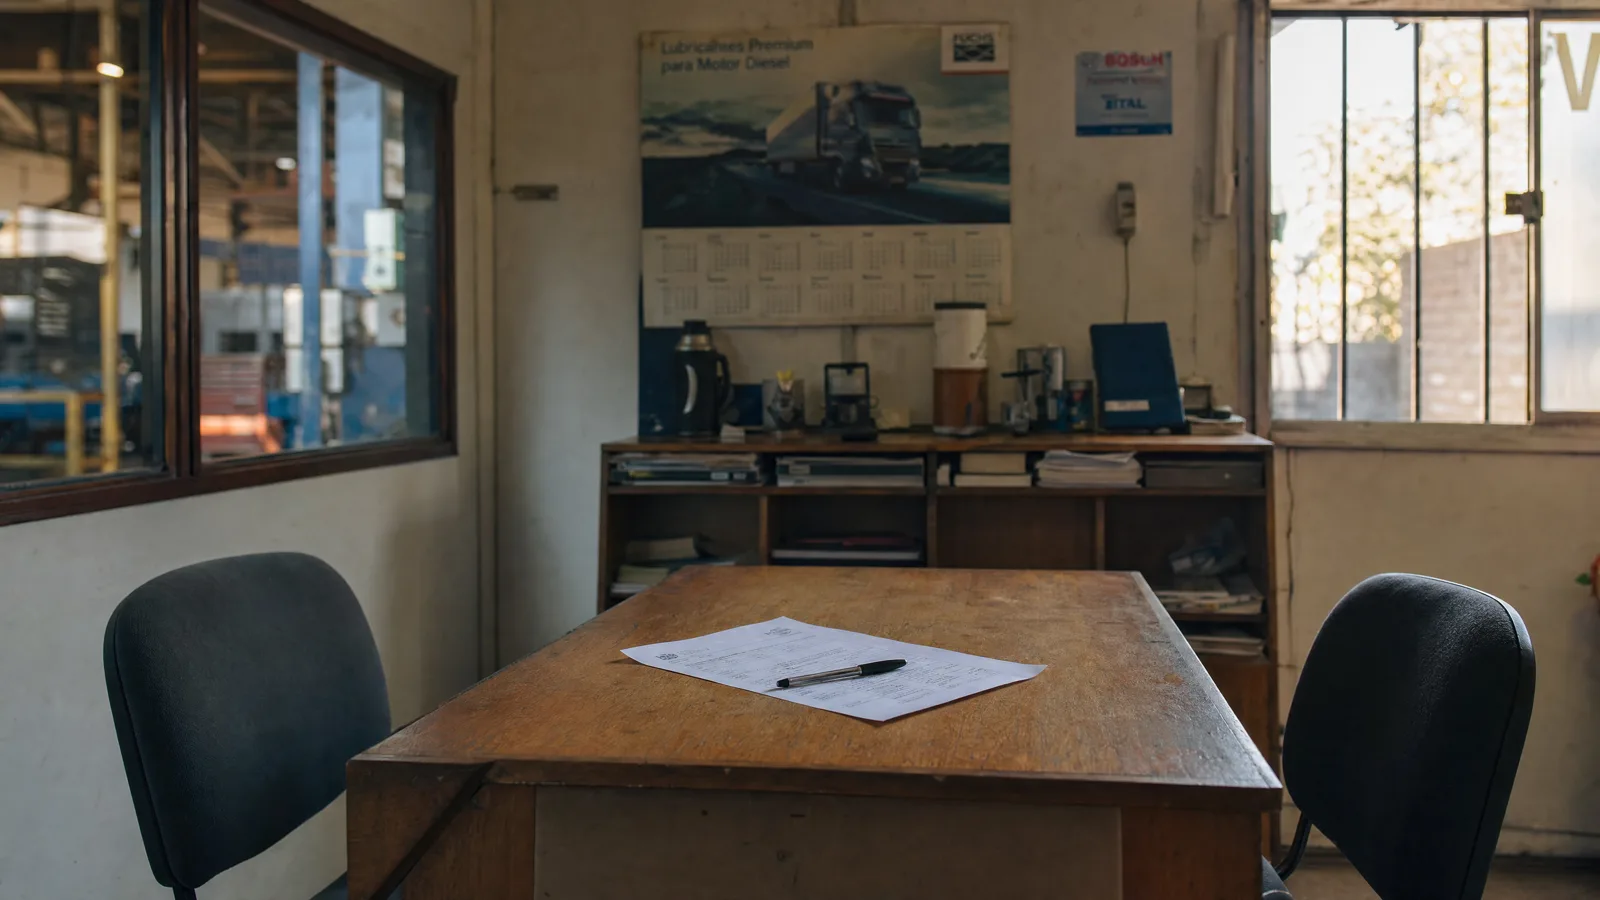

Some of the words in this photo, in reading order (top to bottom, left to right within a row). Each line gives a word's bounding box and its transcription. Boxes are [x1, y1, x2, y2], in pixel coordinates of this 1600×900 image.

[748, 37, 814, 52] Premium
[661, 60, 694, 76] para
[697, 56, 740, 71] Motor
[746, 55, 791, 70] Diesel
